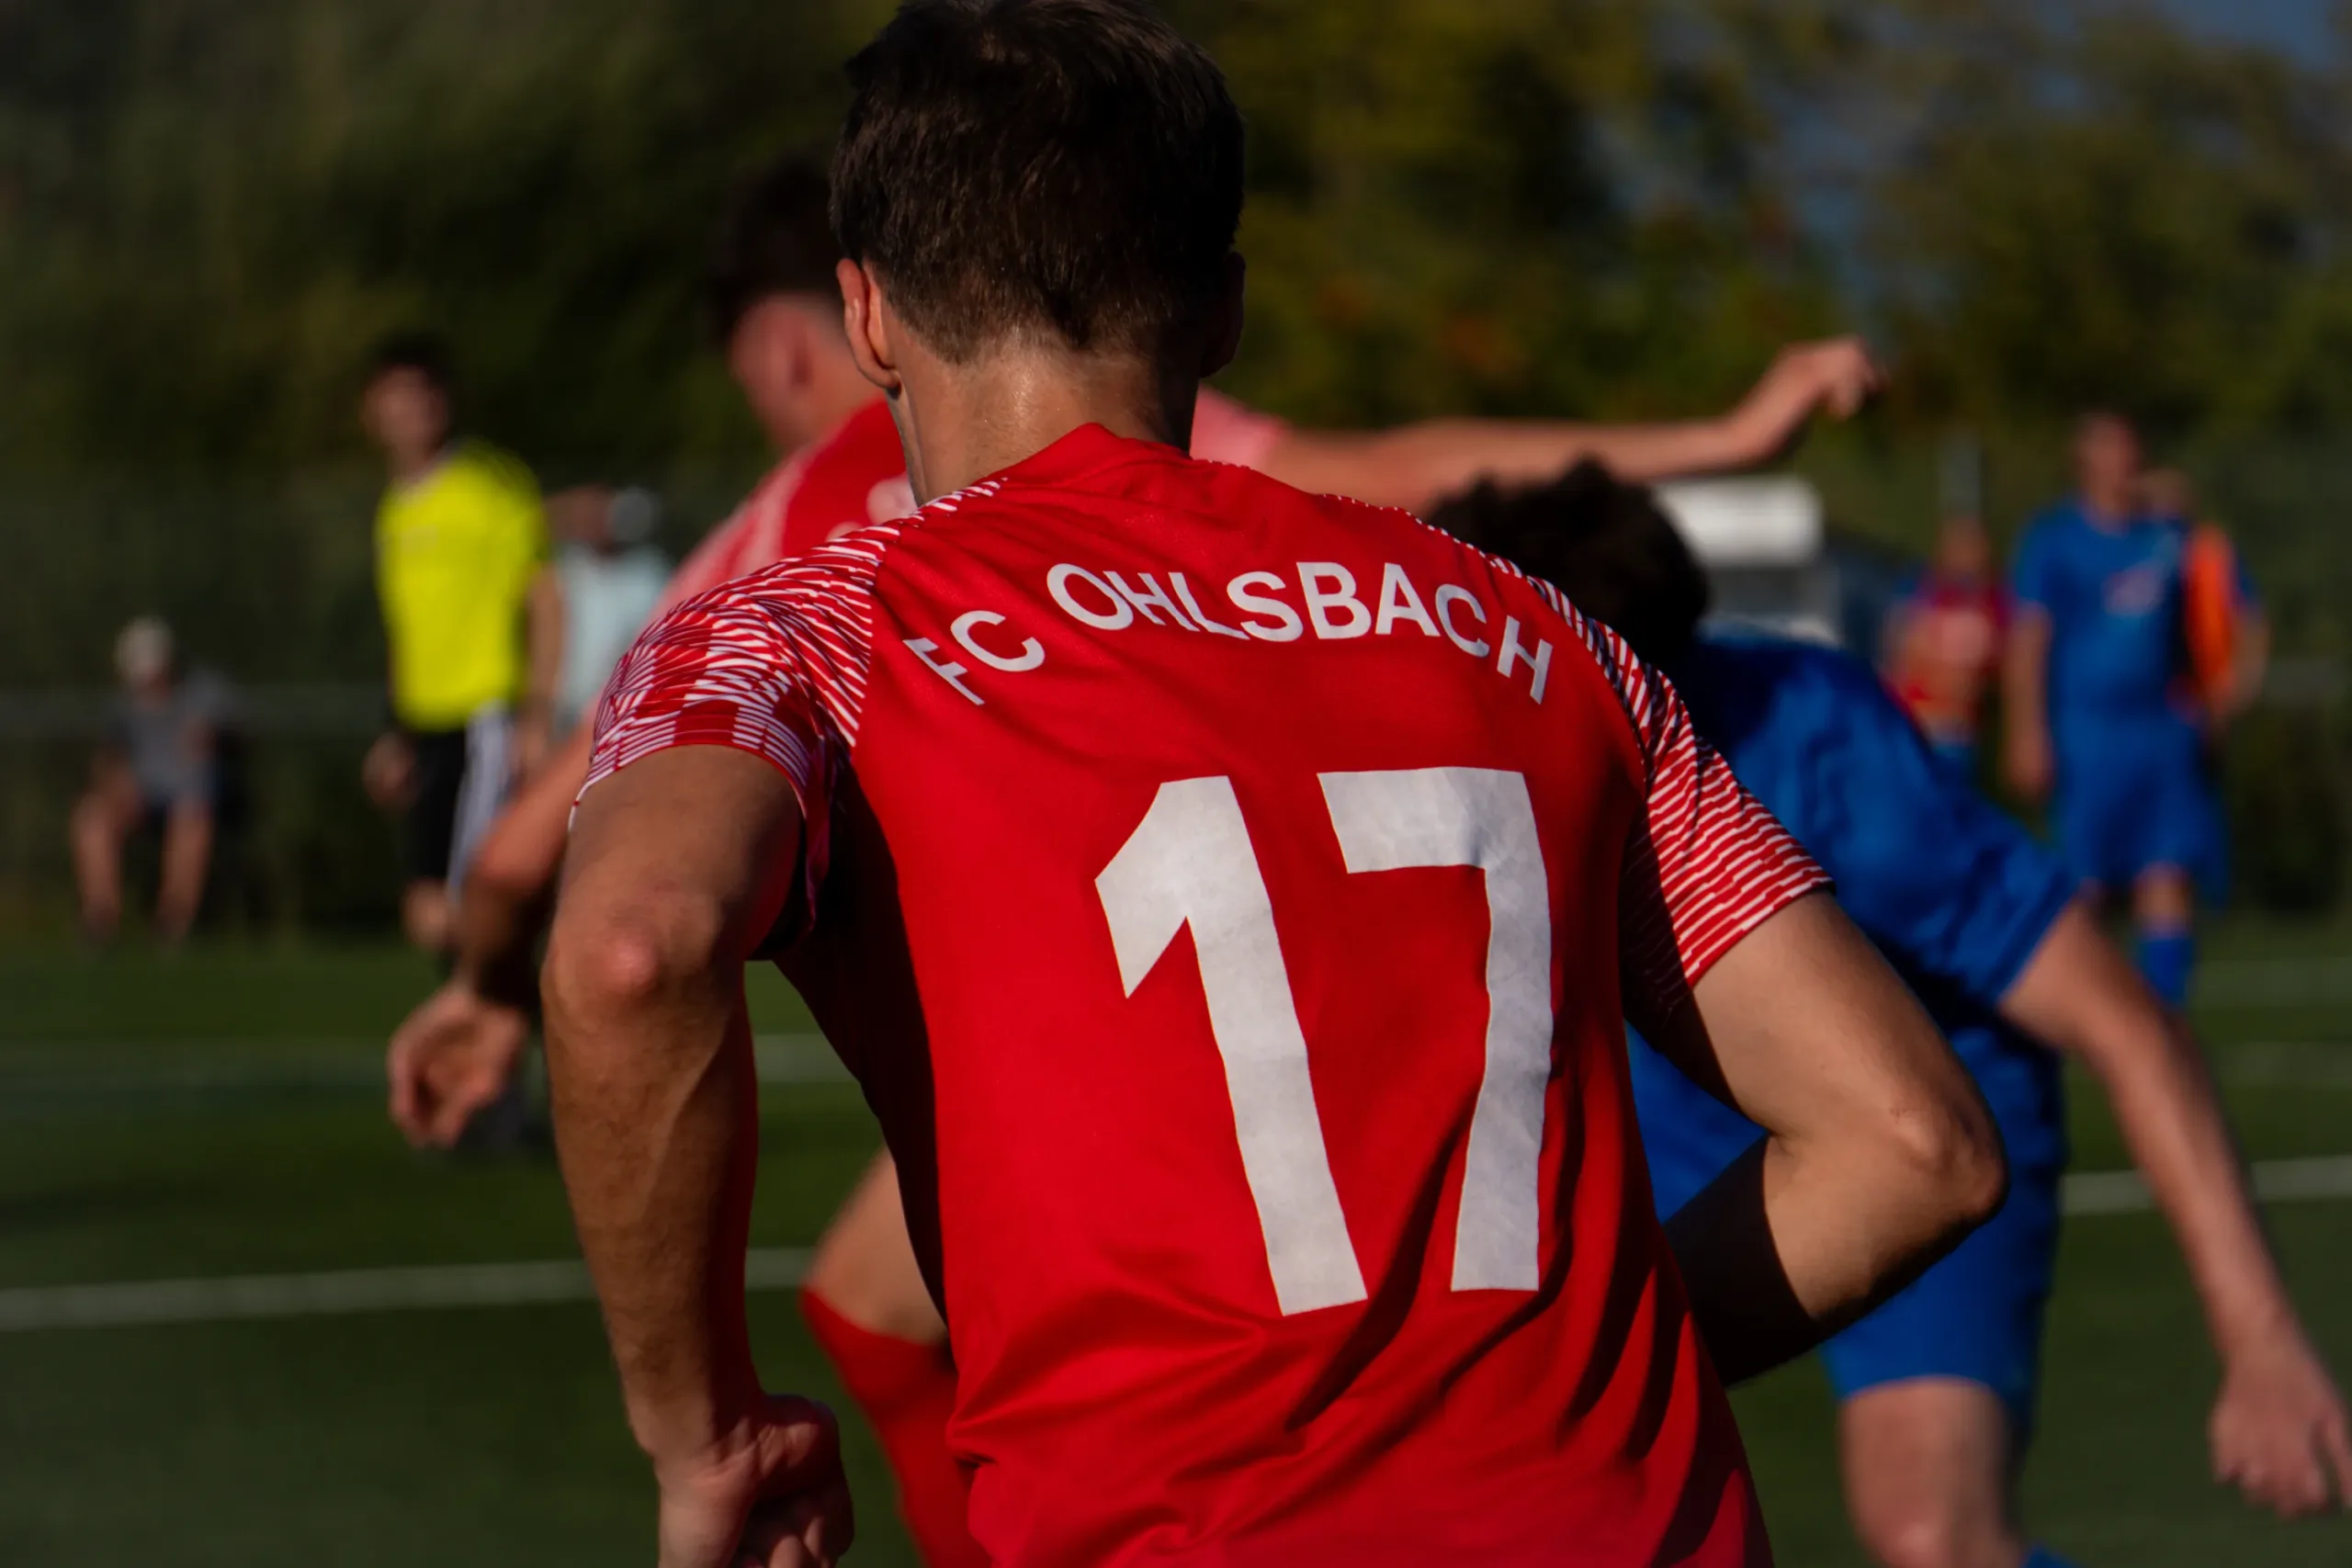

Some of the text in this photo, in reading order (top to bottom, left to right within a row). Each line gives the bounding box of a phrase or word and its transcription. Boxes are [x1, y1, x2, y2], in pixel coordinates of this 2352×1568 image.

[902, 562, 1553, 706] FC OHLSBACH
[1095, 767, 1553, 1315] 17
